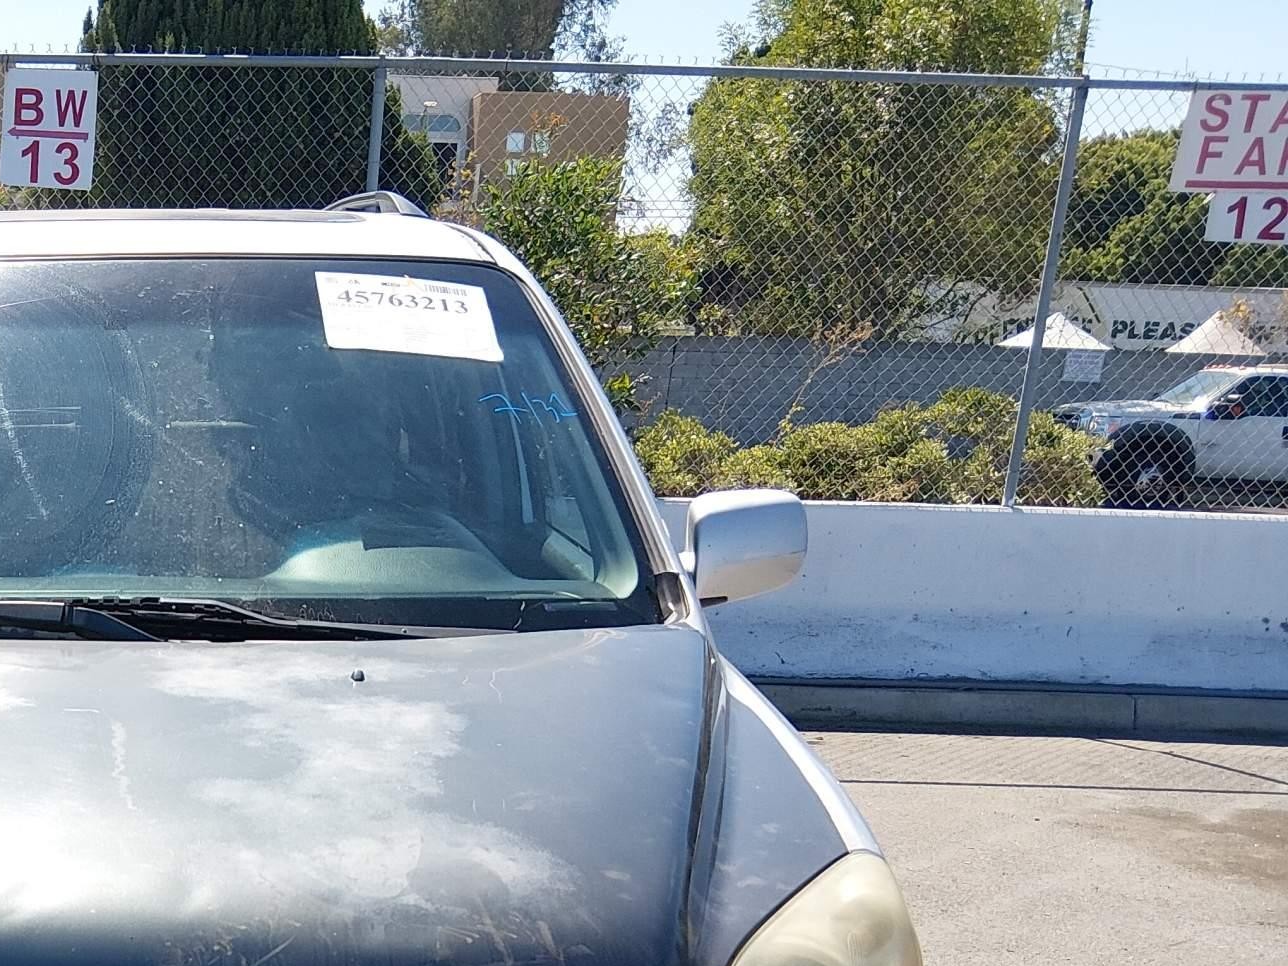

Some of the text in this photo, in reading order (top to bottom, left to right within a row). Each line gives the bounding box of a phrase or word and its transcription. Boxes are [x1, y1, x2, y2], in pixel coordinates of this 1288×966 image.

[13, 87, 88, 128] BW
[21, 139, 80, 185] 13
[1226, 196, 1288, 240] 12
[337, 289, 469, 314] 45763213
[1110, 319, 1202, 341] PLEAS
